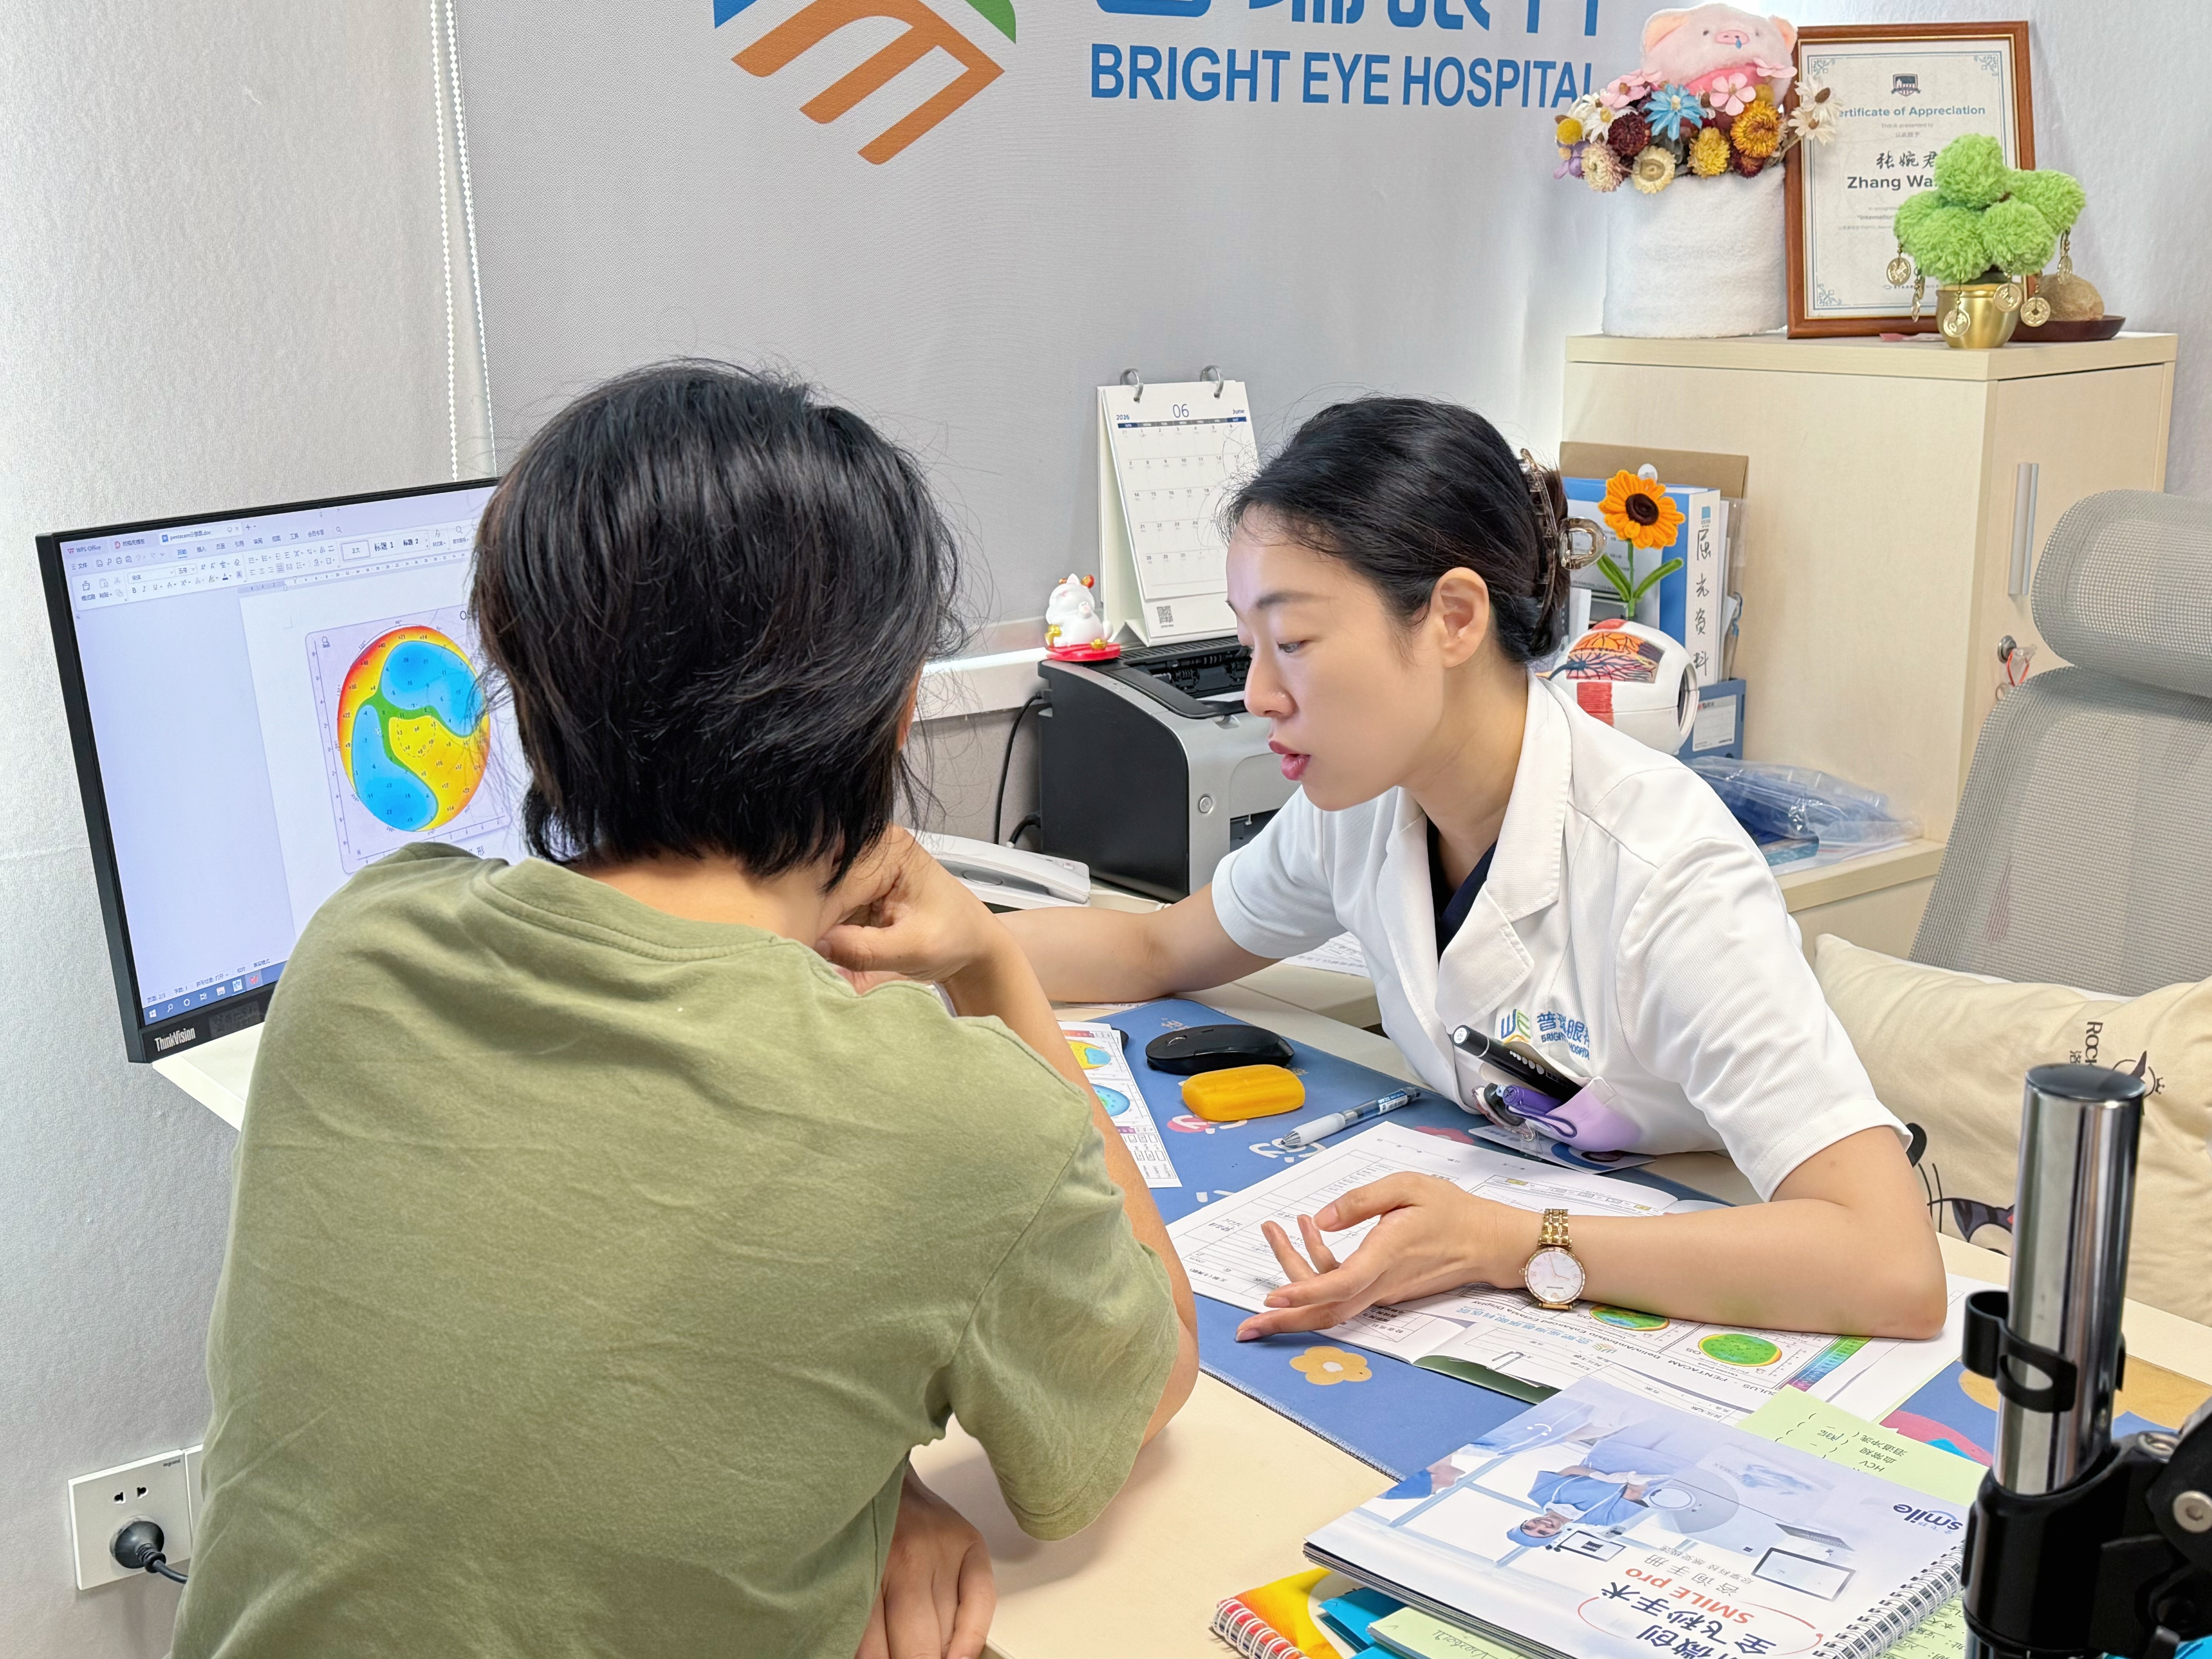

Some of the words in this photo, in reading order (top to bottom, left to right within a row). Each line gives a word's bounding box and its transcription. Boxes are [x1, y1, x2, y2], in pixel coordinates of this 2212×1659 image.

[1092, 43, 1290, 102] BRIGHT
[1303, 52, 1391, 105] EYE
[1839, 107, 1890, 117] ertificate
[1894, 107, 1906, 116] of
[1909, 106, 1985, 117] Appreciation
[1847, 175, 1901, 191] Zhang
[1906, 175, 1938, 188] Wa
[1173, 404, 1189, 418] 06
[155, 1026, 196, 1052] ThinkVision
[1540, 1319, 1587, 1333] Enhanced
[1668, 1360, 1728, 1382] PENTACAM
[1859, 1447, 1897, 1464] 血常规
[1860, 1435, 1908, 1457] 泪道冲洗
[1858, 1460, 1885, 1472] HCV
[1893, 1504, 1963, 1530] smile
[1625, 1568, 1673, 1589] pro
[1644, 1554, 1740, 1597] 咨询手册
[1669, 1585, 1755, 1624] SMILE
[1601, 1581, 1778, 1655] 全飞秒手术
